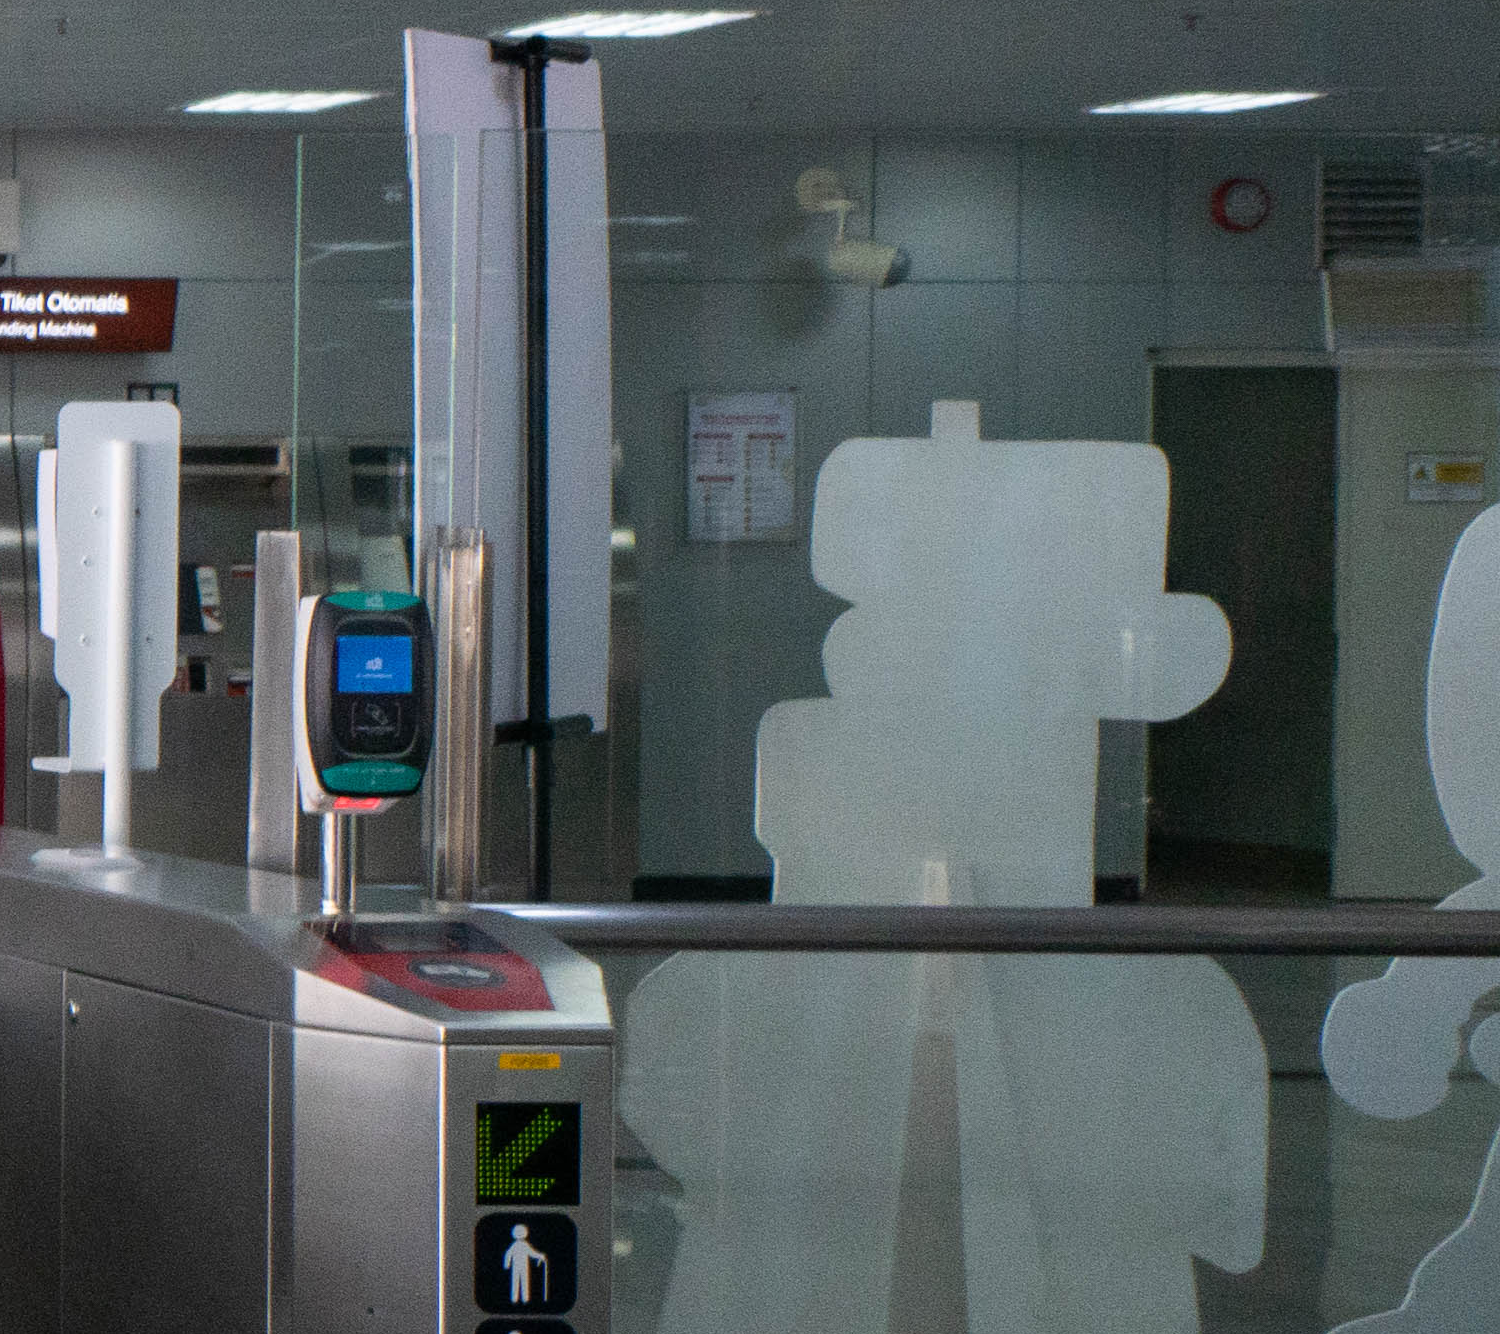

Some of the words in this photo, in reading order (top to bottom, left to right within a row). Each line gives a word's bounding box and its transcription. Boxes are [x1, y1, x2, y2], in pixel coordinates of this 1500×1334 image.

[0, 291, 45, 312] Tiket
[47, 291, 129, 314] Otomatis
[38, 321, 98, 338] Machine
